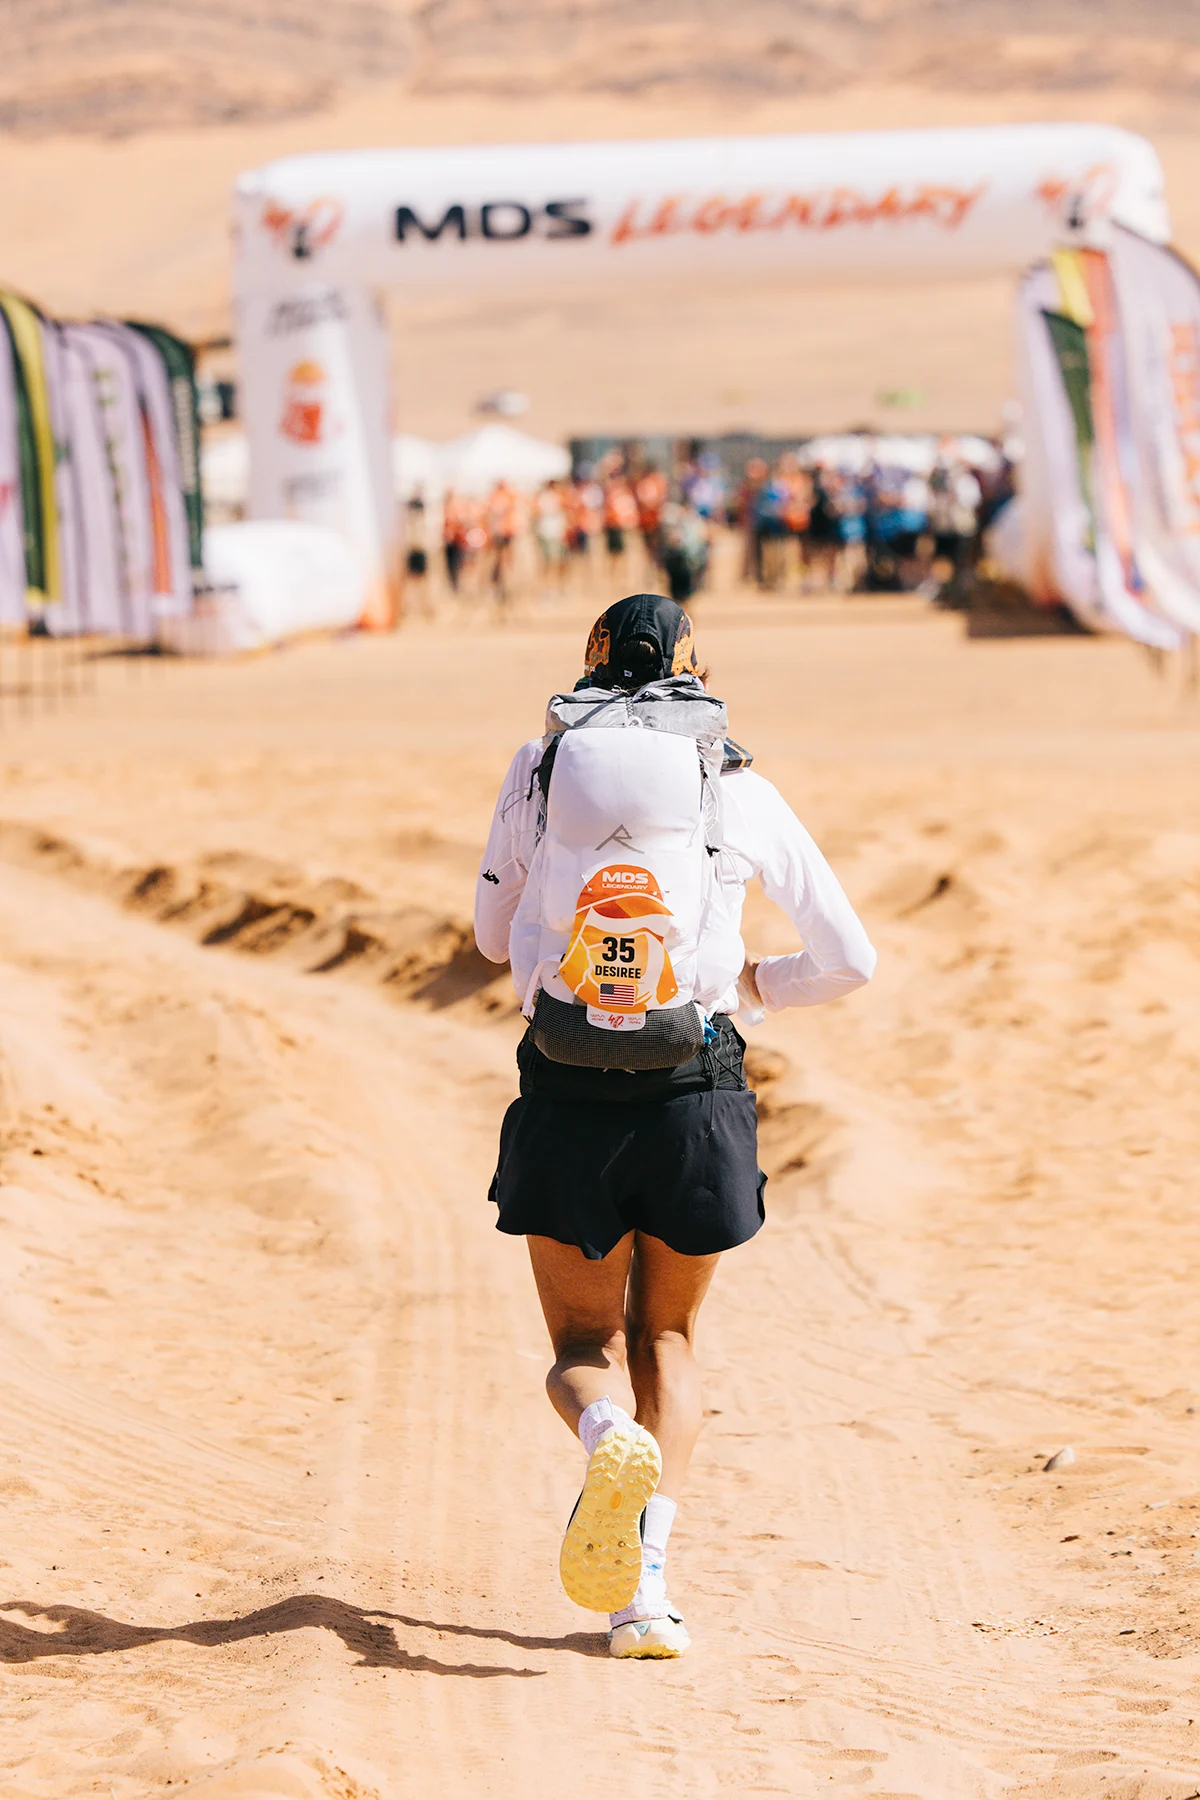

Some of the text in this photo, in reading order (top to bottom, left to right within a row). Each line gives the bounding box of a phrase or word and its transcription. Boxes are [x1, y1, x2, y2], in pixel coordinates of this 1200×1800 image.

[394, 200, 592, 243] MDS
[601, 871, 649, 884] MDS
[602, 936, 635, 963] 35
[594, 965, 641, 979] DESIREE
